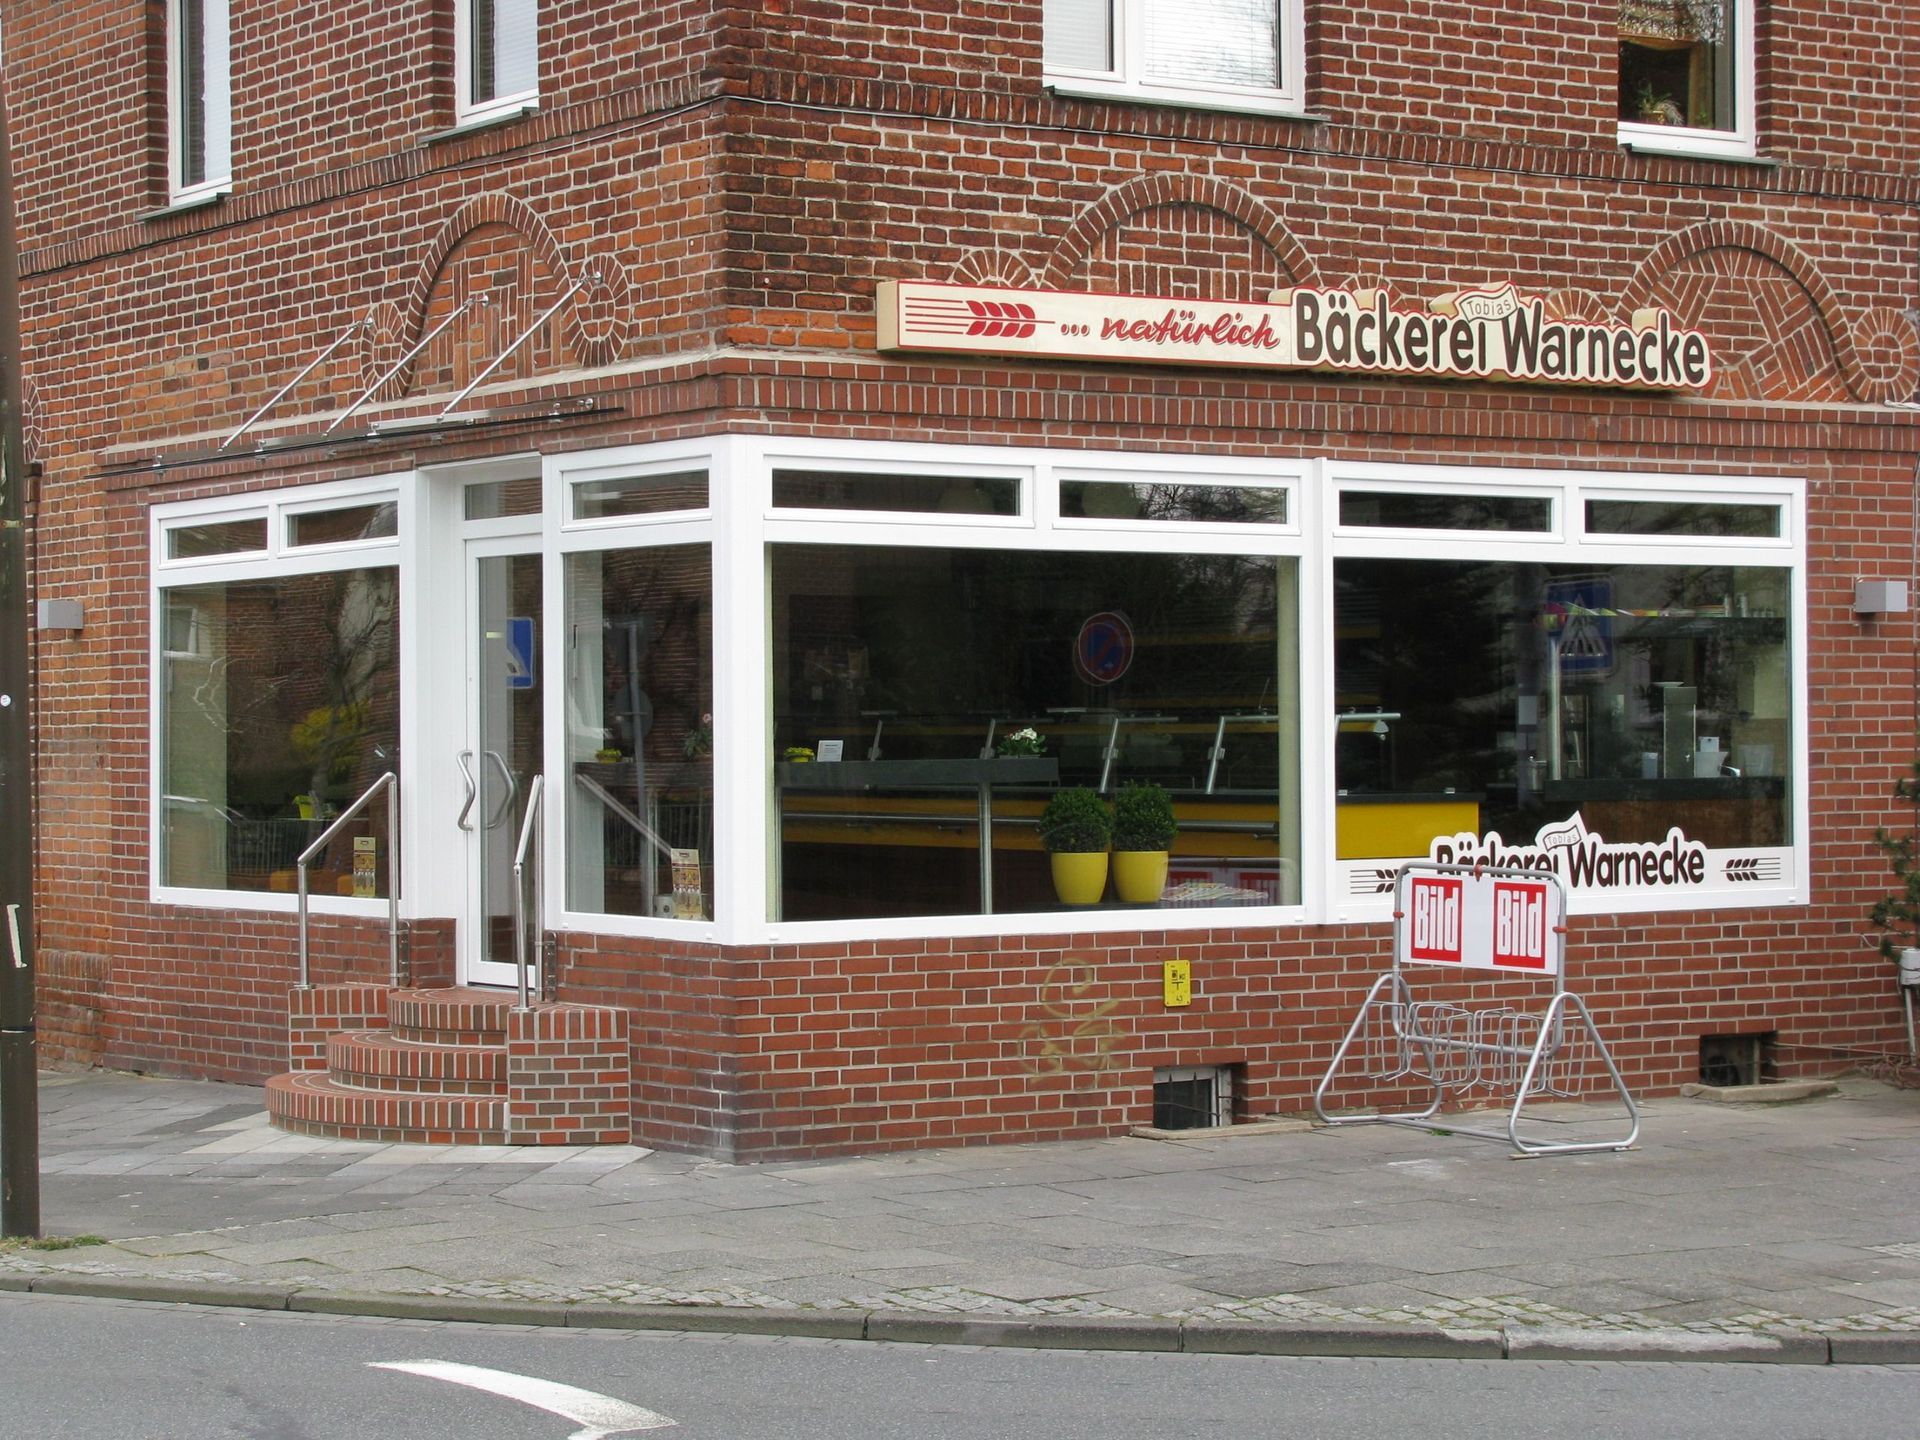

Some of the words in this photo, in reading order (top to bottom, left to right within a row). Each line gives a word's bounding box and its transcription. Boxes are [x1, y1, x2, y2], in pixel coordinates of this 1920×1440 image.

[1100, 308, 1281, 350] natürlich
[1467, 298, 1512, 317] Tobias
[1296, 292, 1487, 372] Bäckerei
[1501, 300, 1705, 385] Warnecke
[1547, 833, 1577, 846] Tobias
[1567, 835, 1705, 888] Warnecke
[1414, 885, 1460, 951] Bild
[1496, 889, 1543, 958] Bild
